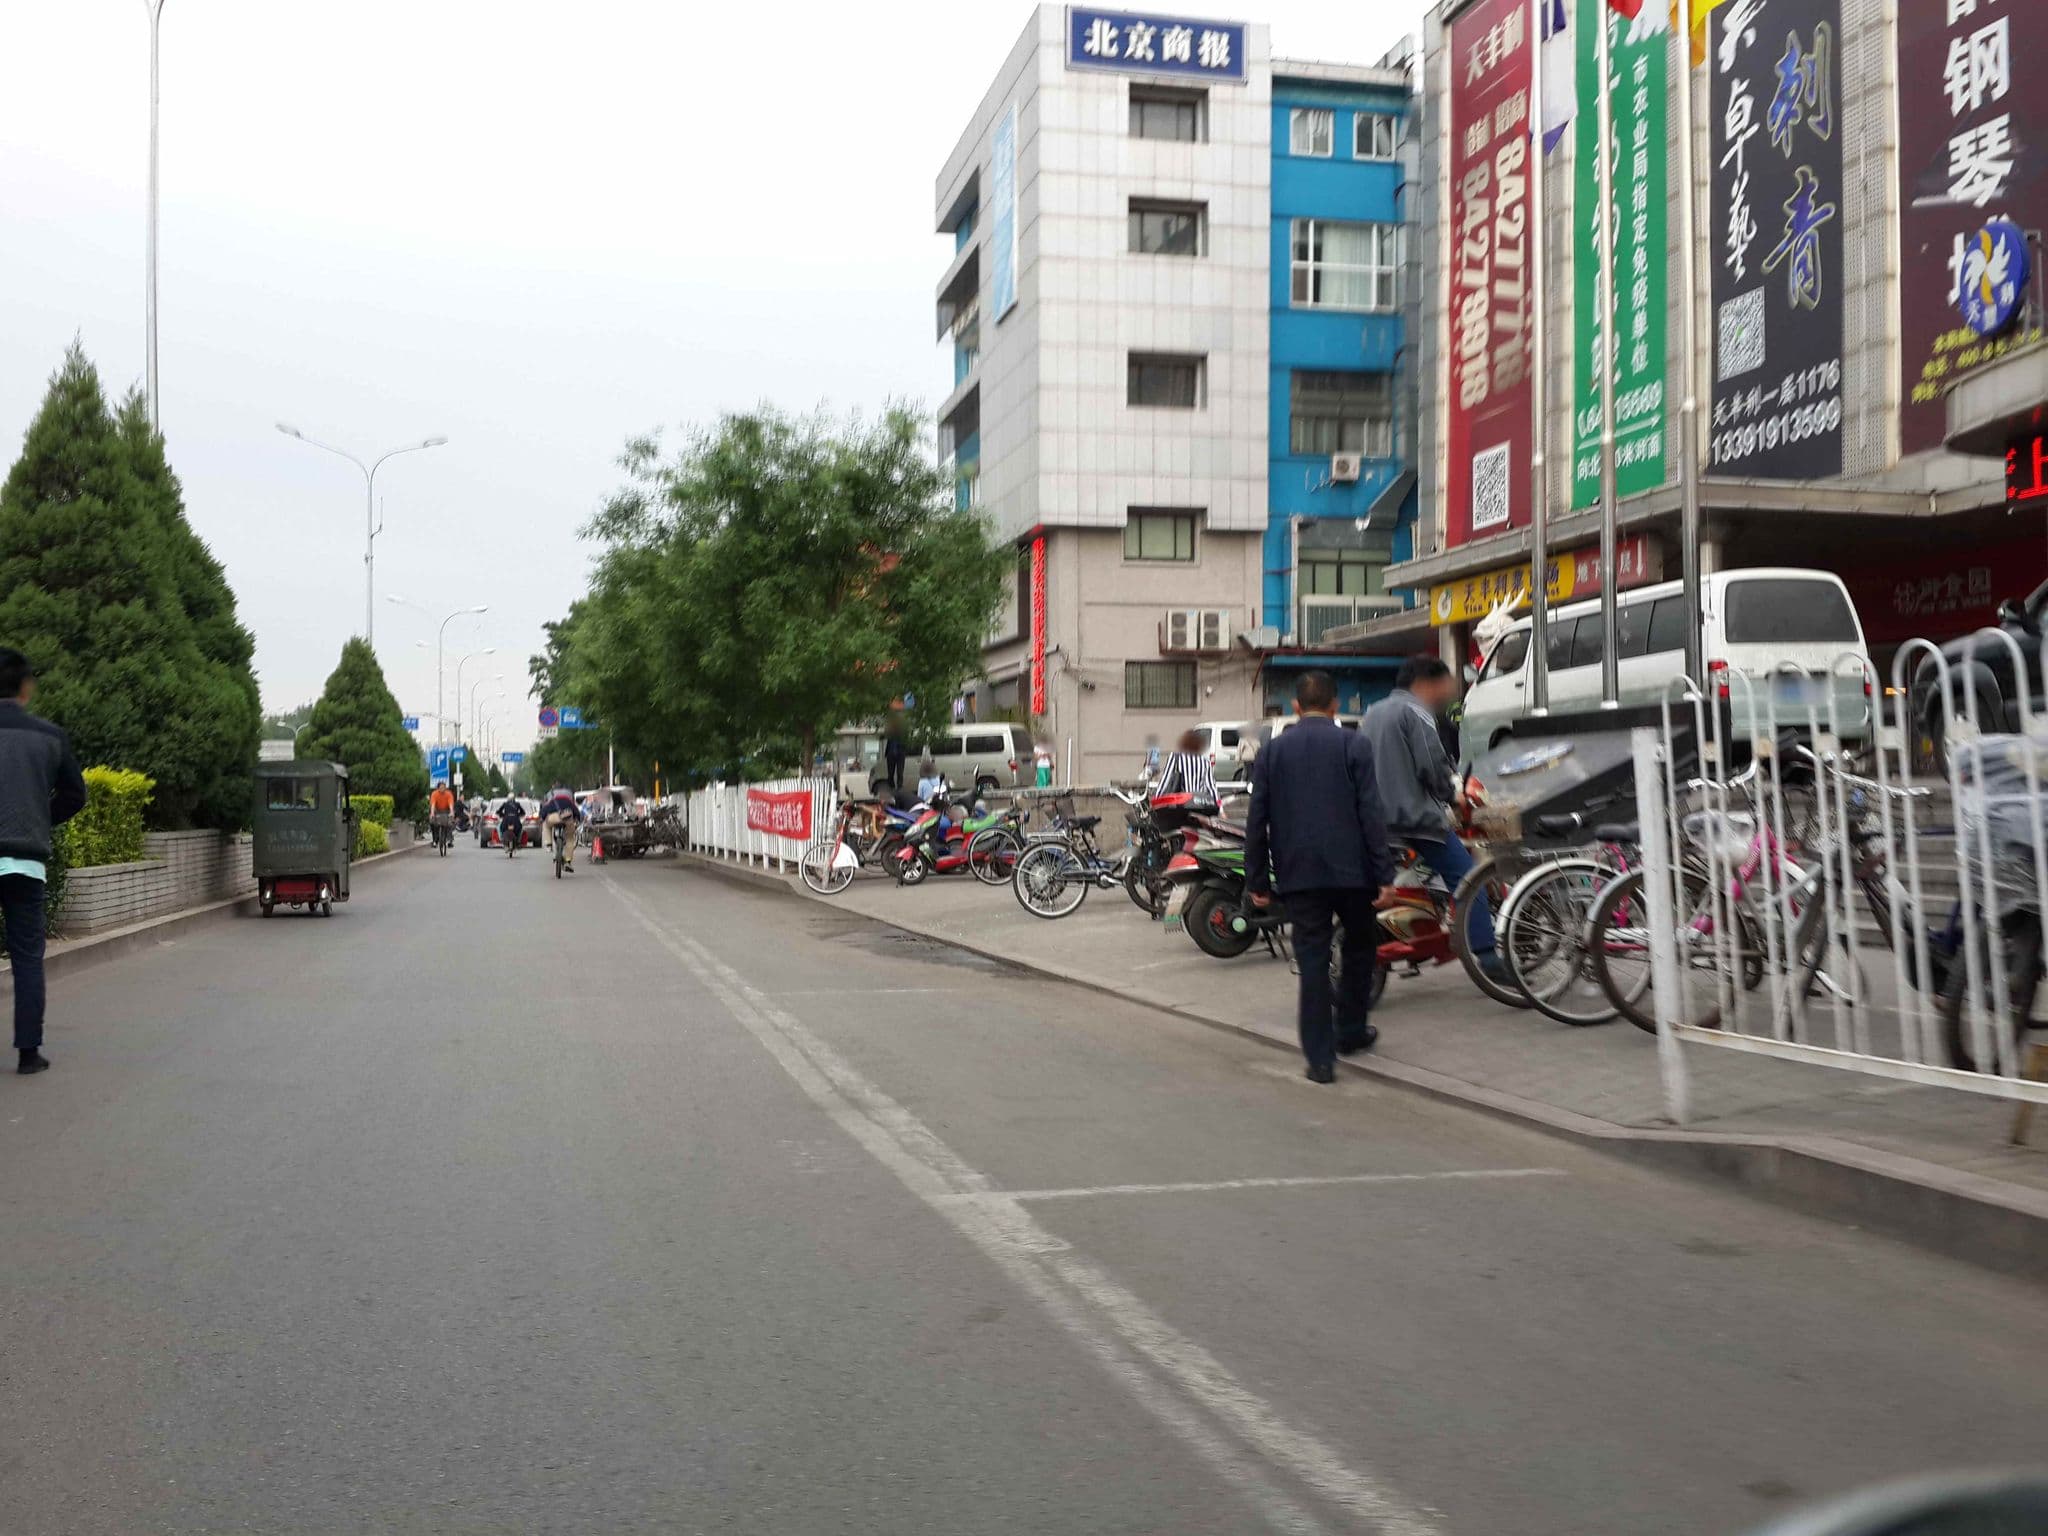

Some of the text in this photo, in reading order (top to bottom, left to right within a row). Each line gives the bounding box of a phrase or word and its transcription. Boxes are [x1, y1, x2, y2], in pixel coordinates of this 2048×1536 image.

[1084, 18, 1231, 69] 北京商报
[1761, 20, 1836, 310] 刺青
[1711, 395, 1840, 466] 13391913599
[1576, 550, 1631, 584] 地下层
